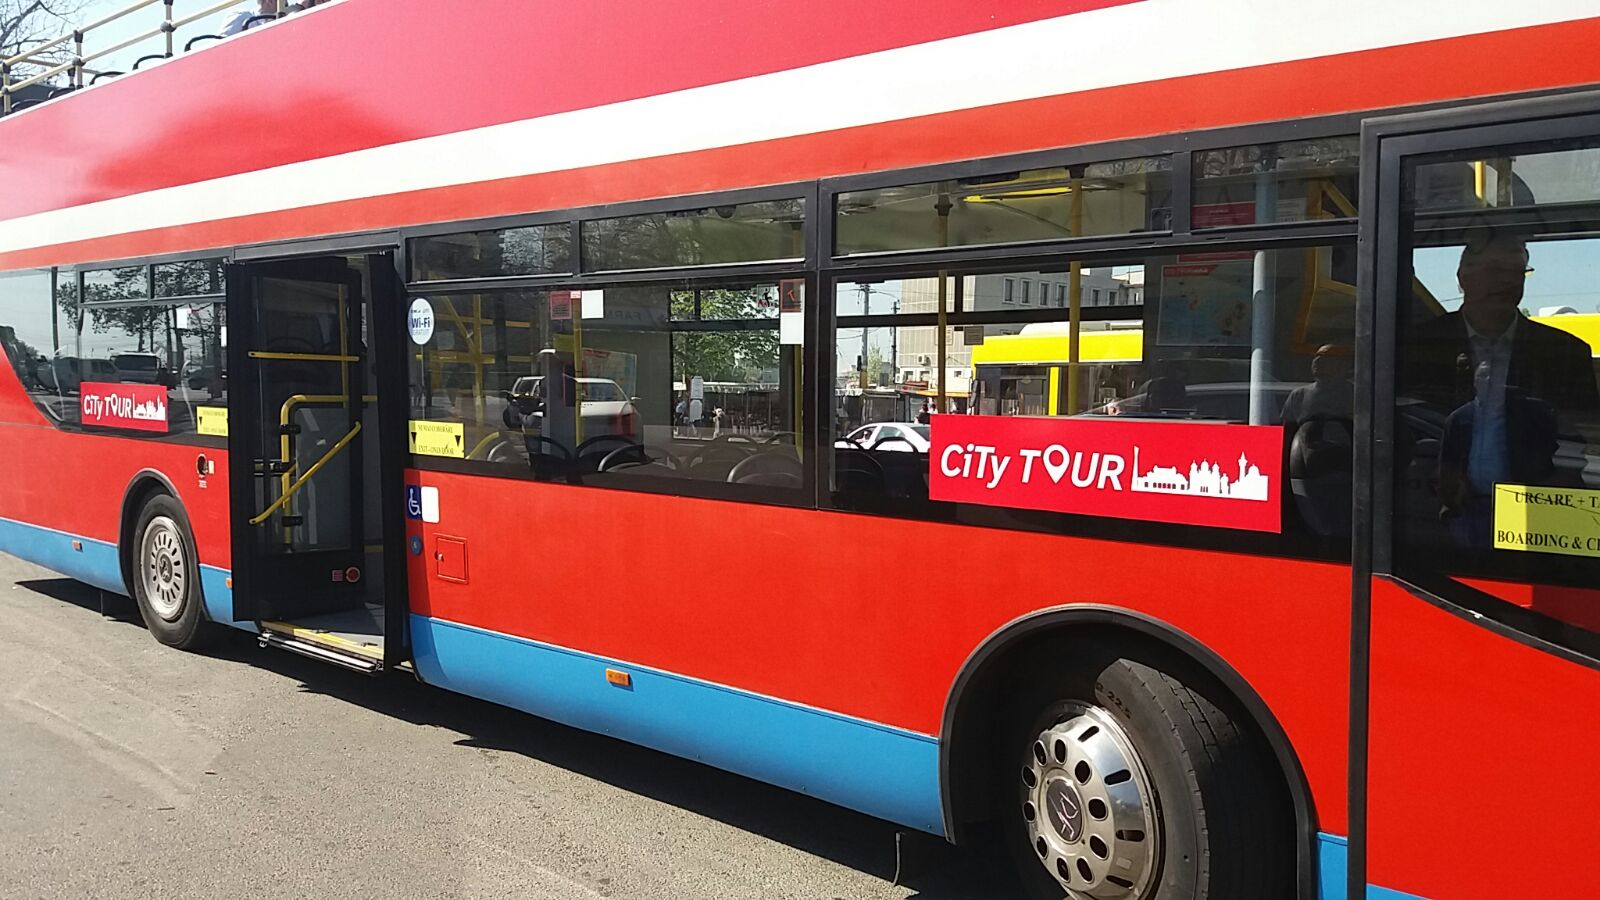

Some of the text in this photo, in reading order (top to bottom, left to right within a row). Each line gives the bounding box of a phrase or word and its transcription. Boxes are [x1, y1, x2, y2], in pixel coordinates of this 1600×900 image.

[411, 316, 431, 329] Wi-Fi
[104, 393, 132, 419] TOUR
[1019, 444, 1126, 491] TOUR
[1515, 491, 1573, 507] URCARE
[1497, 530, 1569, 549] BOARDING
[1571, 536, 1582, 550] &
